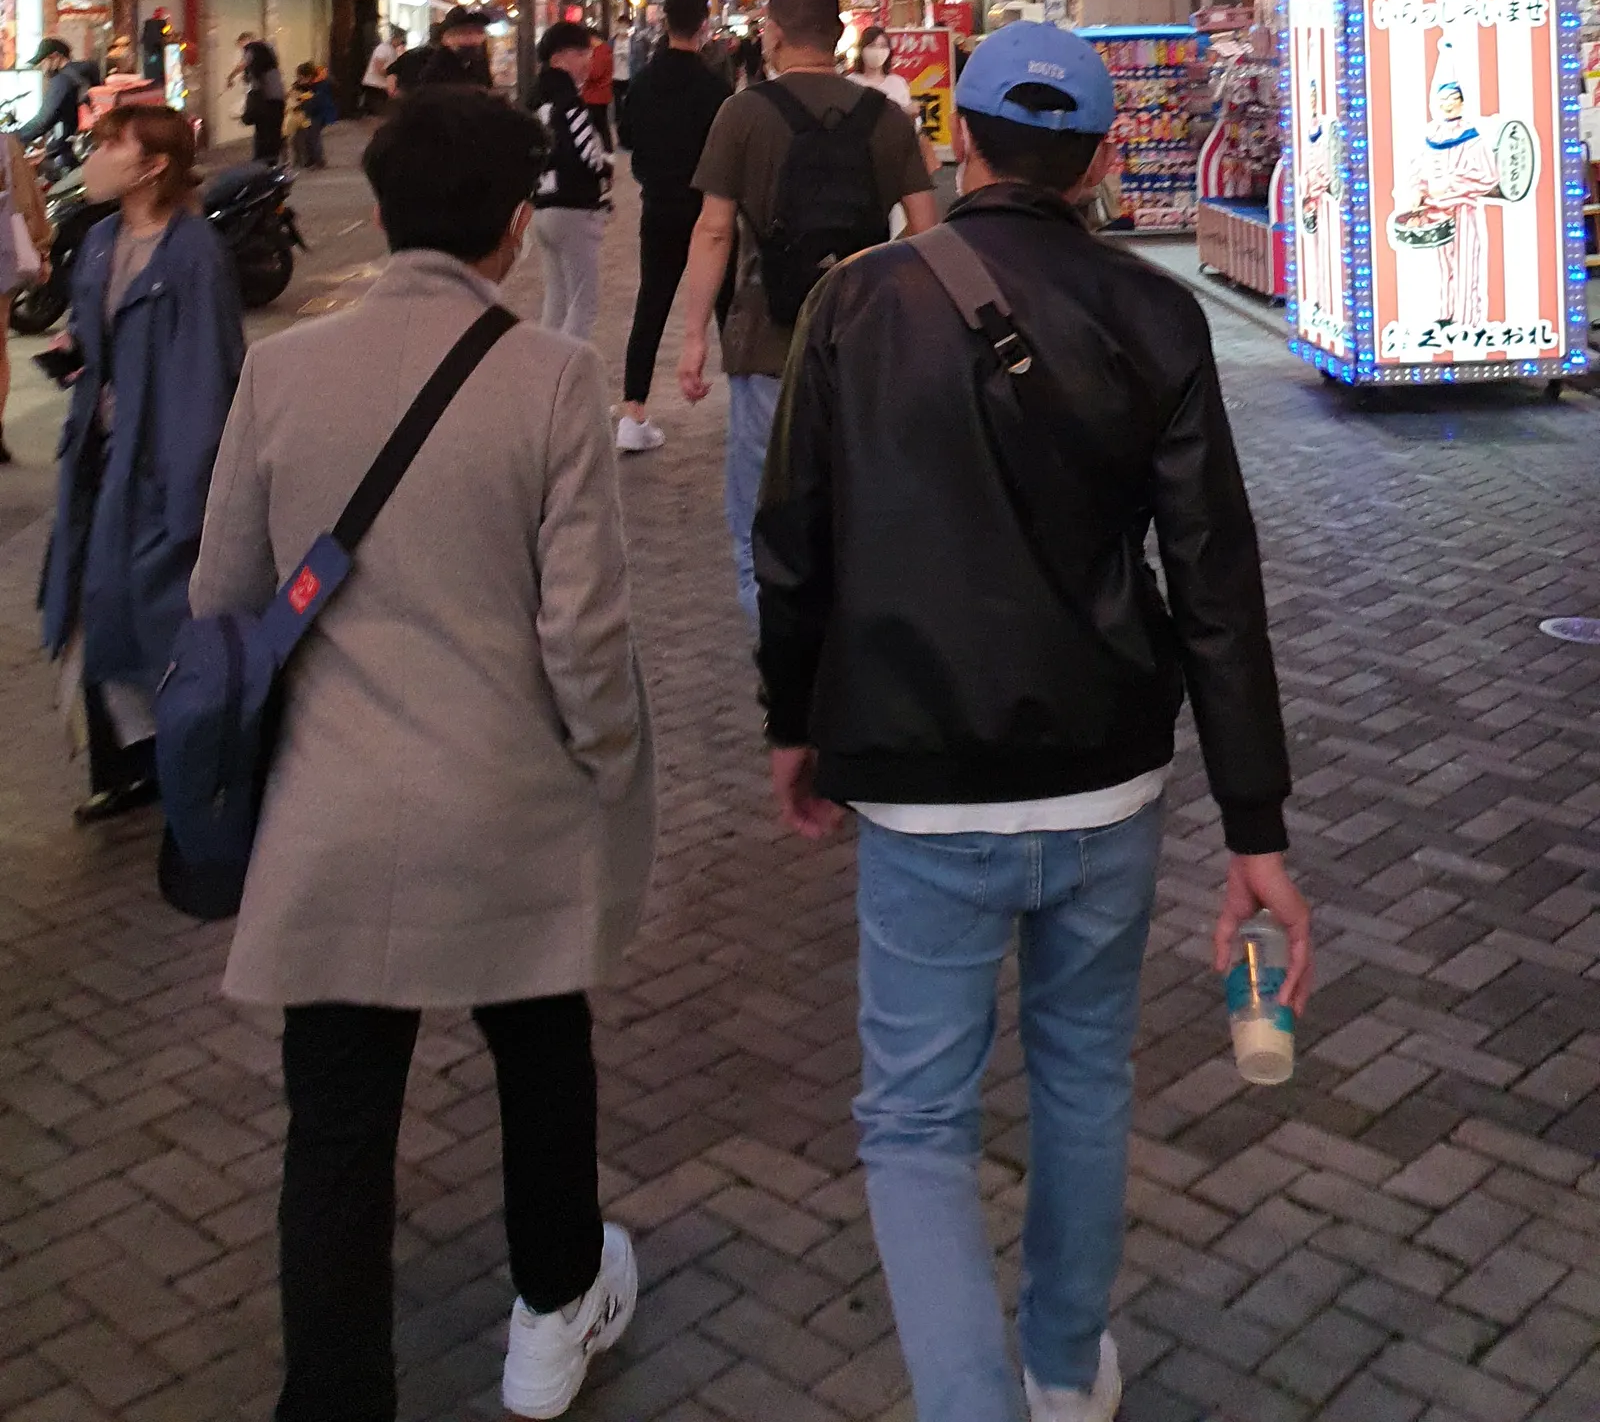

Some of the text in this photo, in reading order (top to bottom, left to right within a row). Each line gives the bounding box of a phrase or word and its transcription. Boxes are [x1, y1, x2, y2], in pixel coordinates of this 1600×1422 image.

[1378, 0, 1544, 24] いらっしゃいませ
